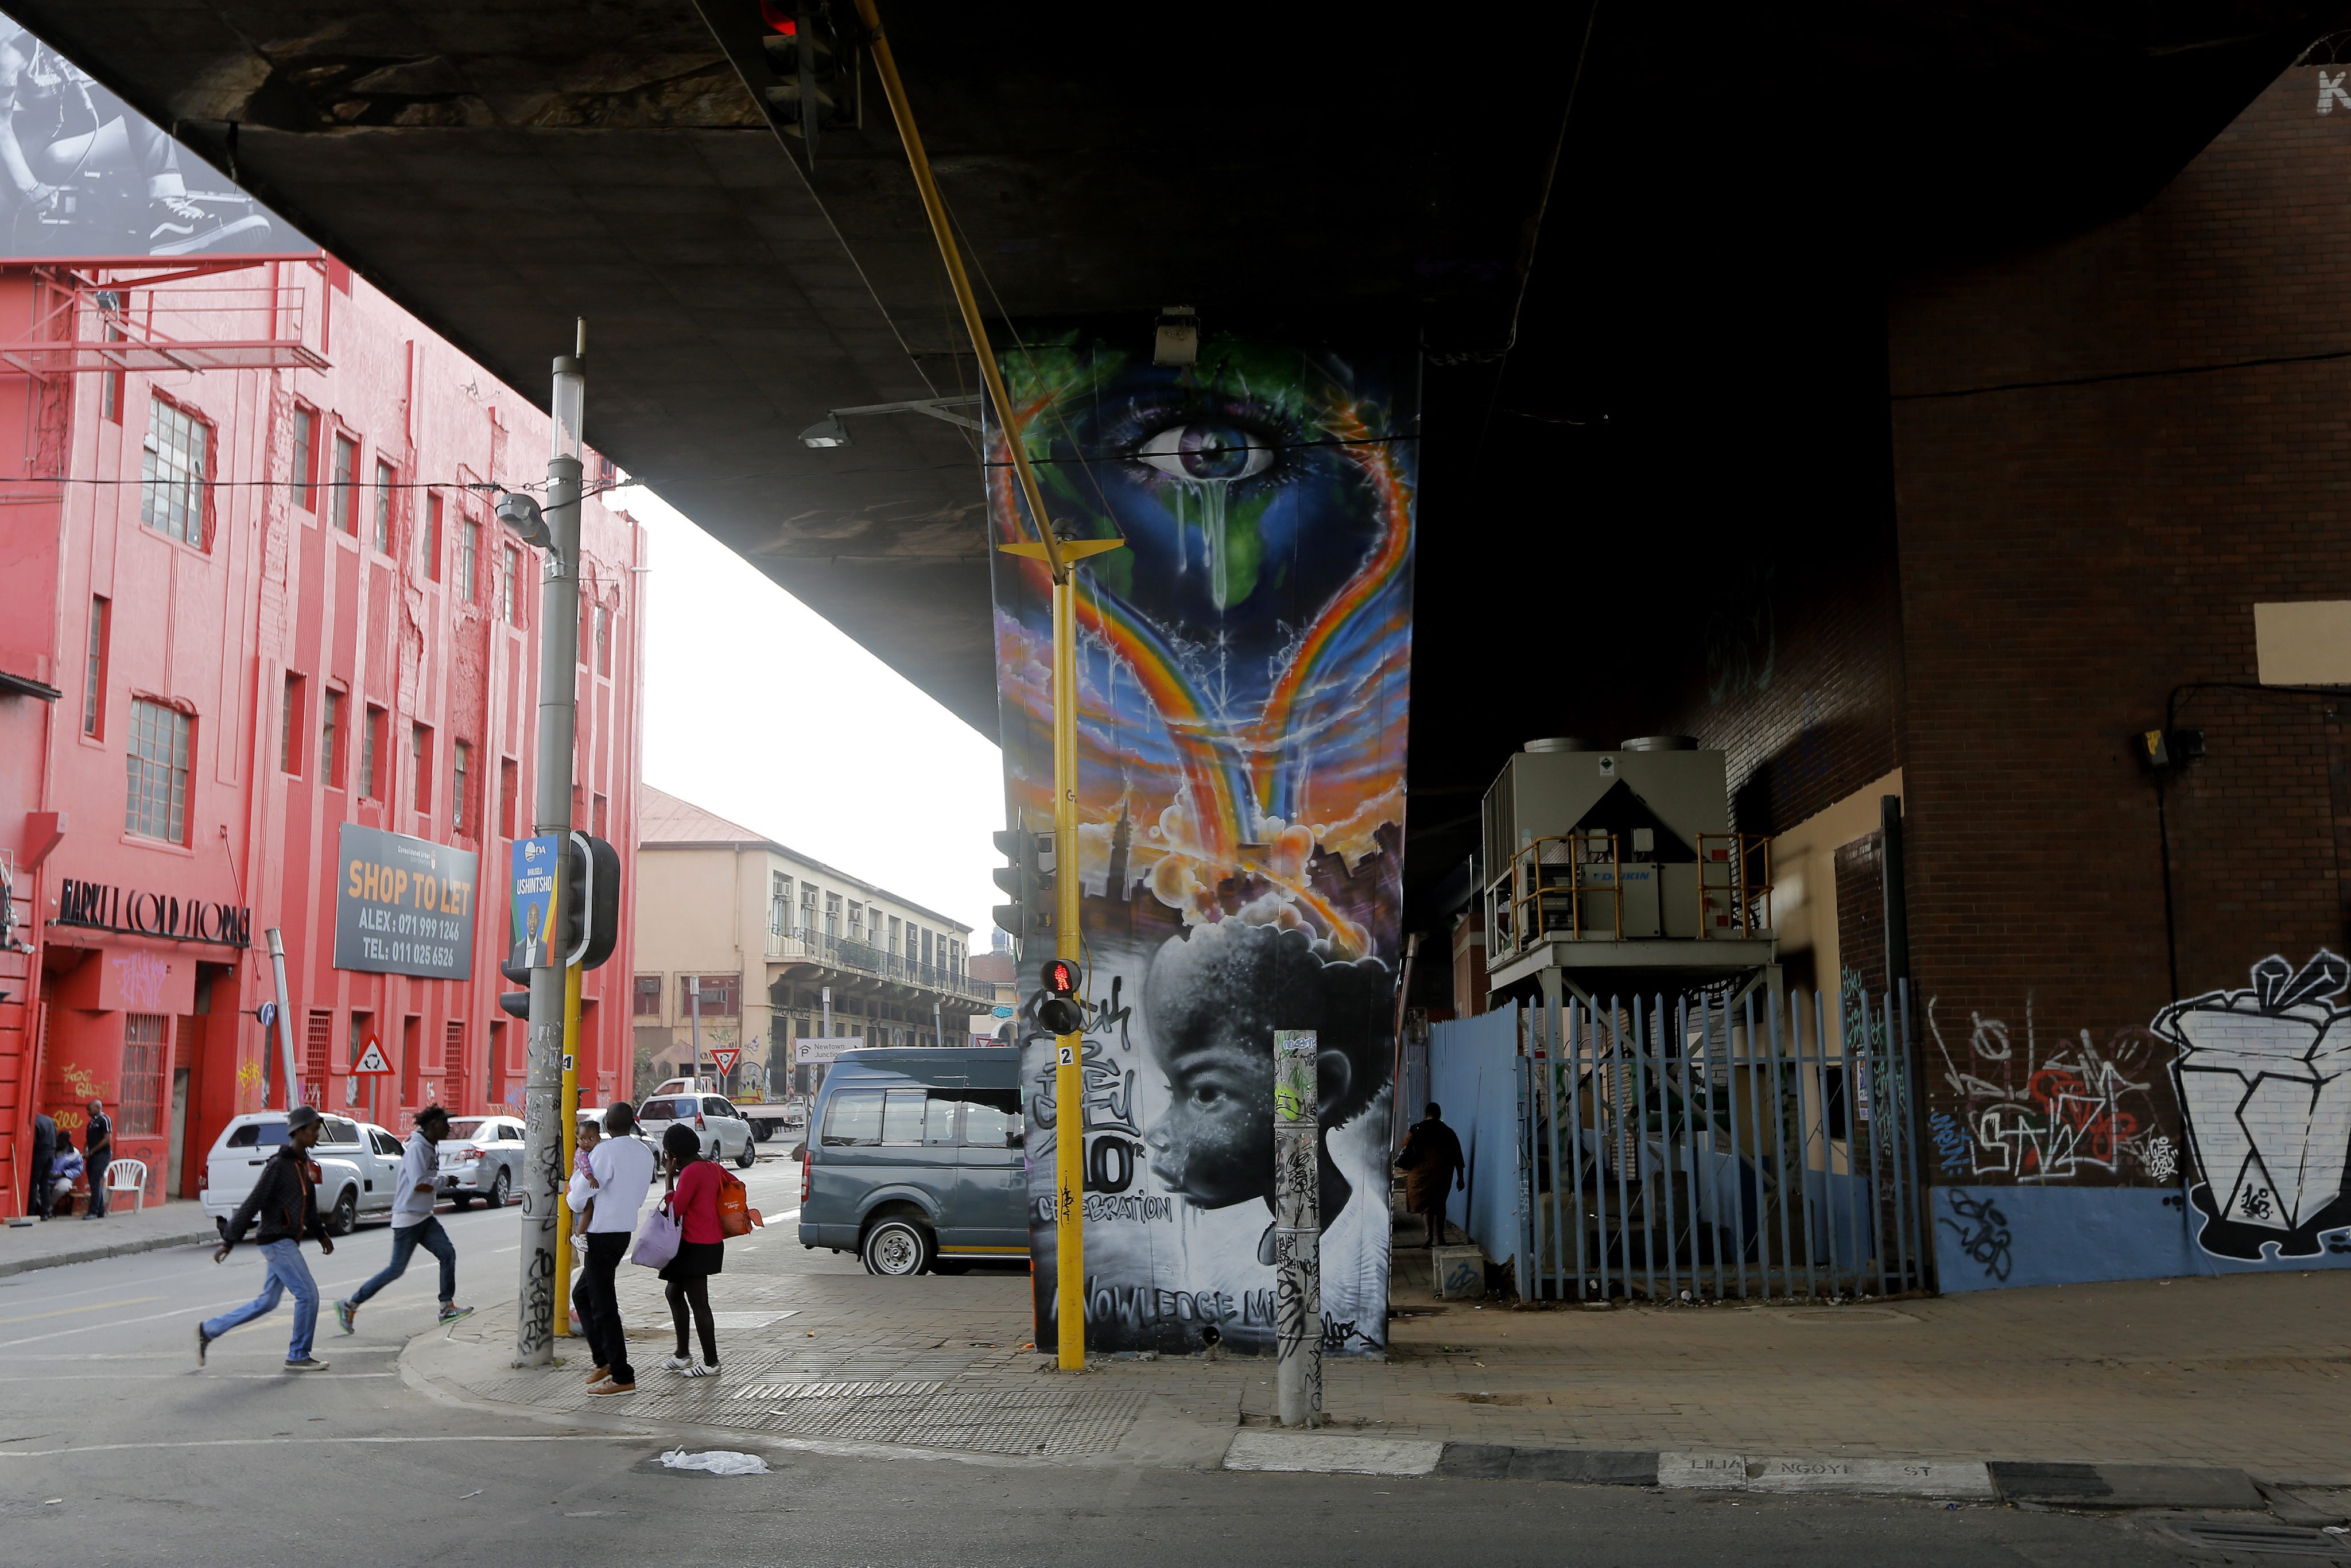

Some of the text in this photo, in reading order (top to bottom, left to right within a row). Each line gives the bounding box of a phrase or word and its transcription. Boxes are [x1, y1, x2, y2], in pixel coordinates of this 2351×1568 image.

[535, 845, 546, 855] DA
[348, 859, 471, 917] SHOP TO LET
[517, 876, 552, 895] USHINTSHO
[398, 913, 417, 936] 071
[420, 917, 437, 938] 999
[439, 919, 459, 941] 1246
[363, 937, 453, 968] TEL: 011 025 6526
[1061, 1049, 1072, 1064] 2
[1692, 1460, 1931, 1476] LILIA NGOYI ST
